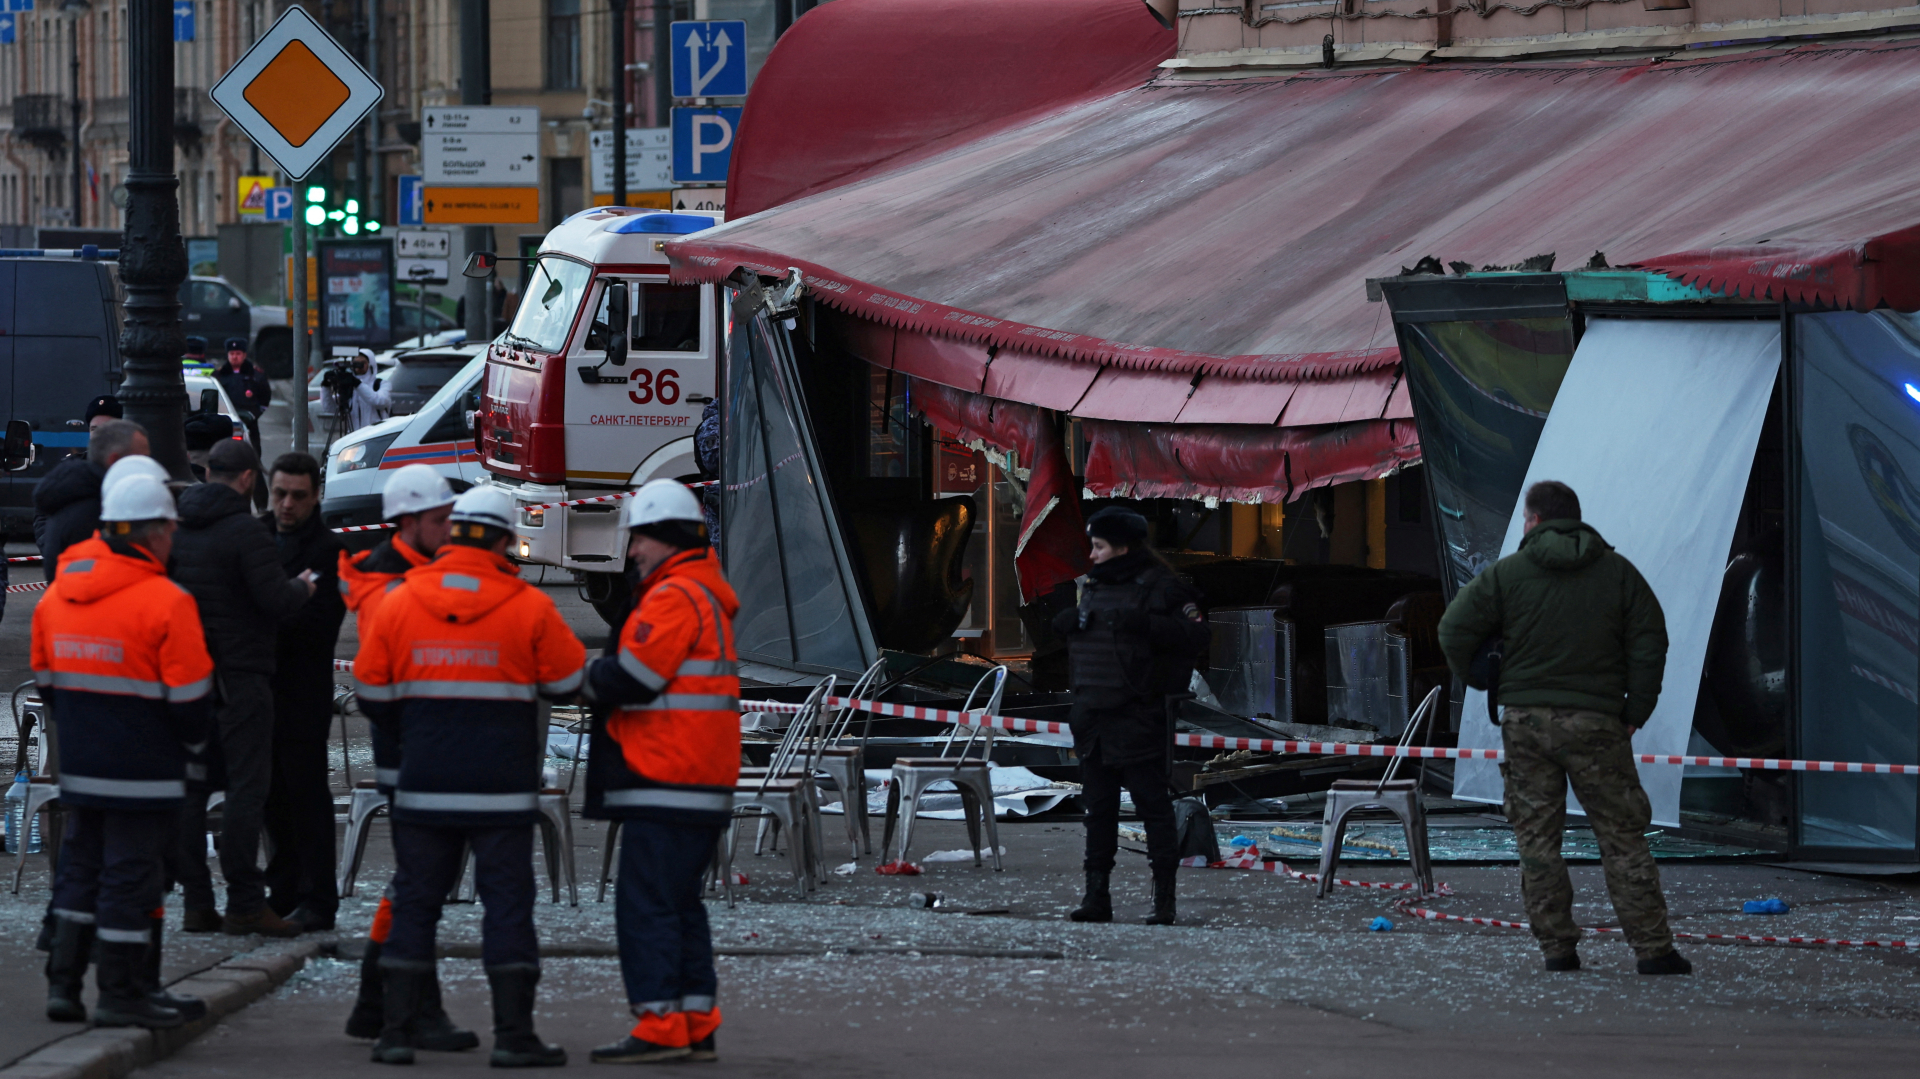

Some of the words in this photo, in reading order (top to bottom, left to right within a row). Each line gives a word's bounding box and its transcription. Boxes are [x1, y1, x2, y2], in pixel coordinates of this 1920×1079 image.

[692, 114, 732, 174] P
[443, 160, 486, 168] БОЛЬШОЙ
[273, 191, 292, 218] P
[1789, 264, 1812, 281] БАР
[629, 368, 680, 405] 36
[590, 415, 690, 426] САНКТ-ПЕТЕРБУРГ
